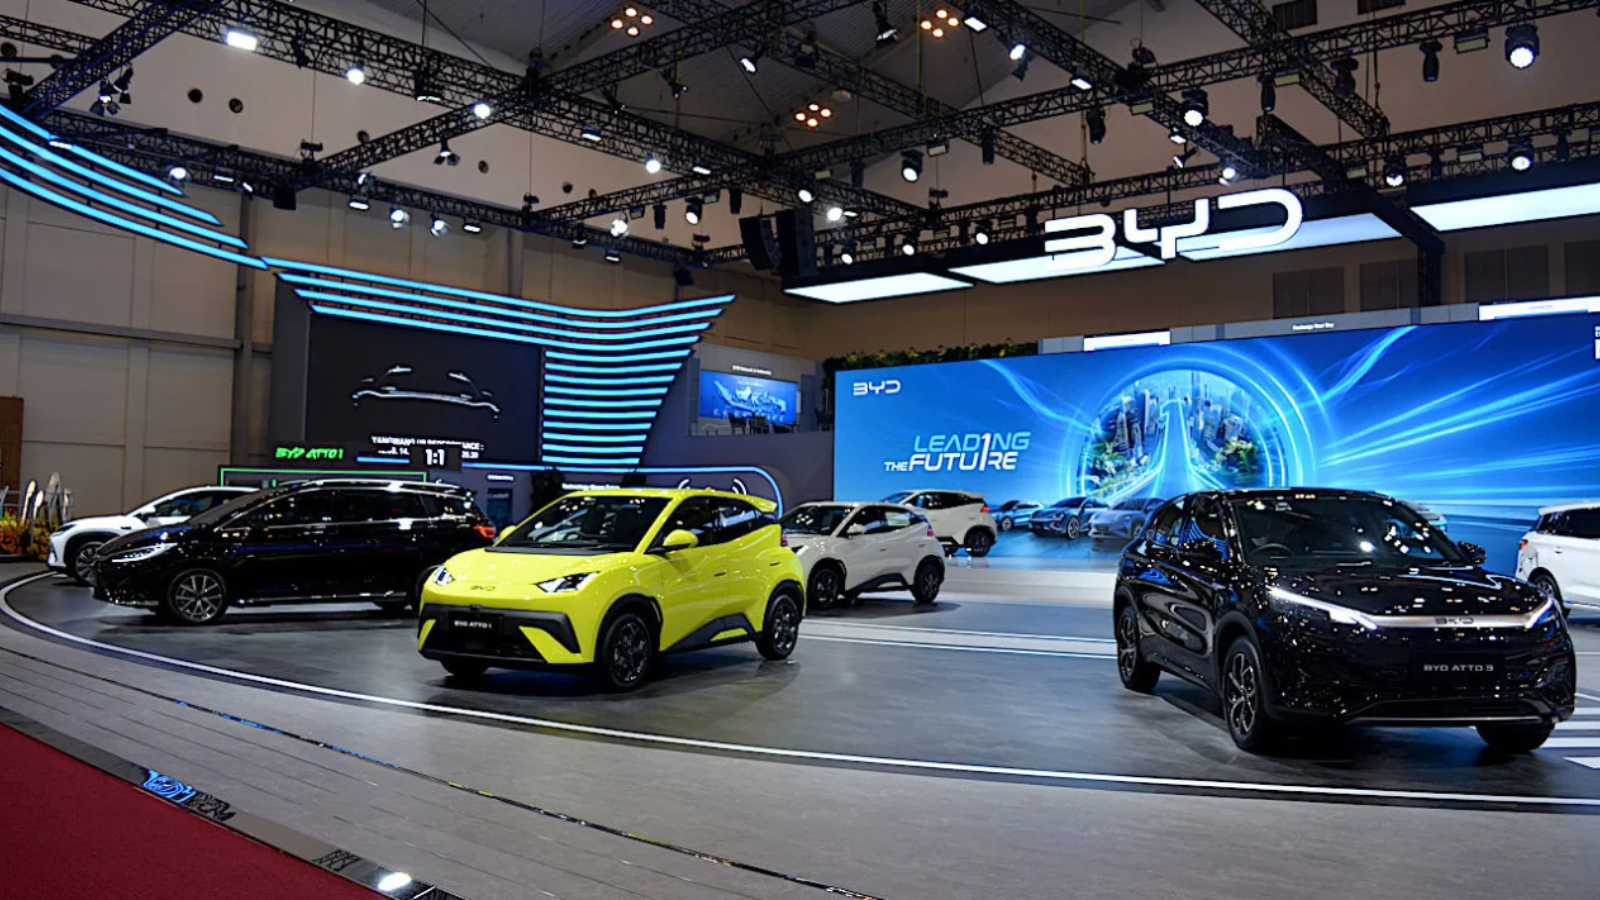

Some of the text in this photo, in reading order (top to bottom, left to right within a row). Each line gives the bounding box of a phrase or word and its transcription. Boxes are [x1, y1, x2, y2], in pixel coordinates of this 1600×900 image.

[1045, 188, 1302, 270] BYD
[853, 380, 901, 395] BYD
[425, 448, 445, 466] 1:1
[884, 461, 908, 471] THE
[1423, 664, 1494, 672] BYD ATTO 3
